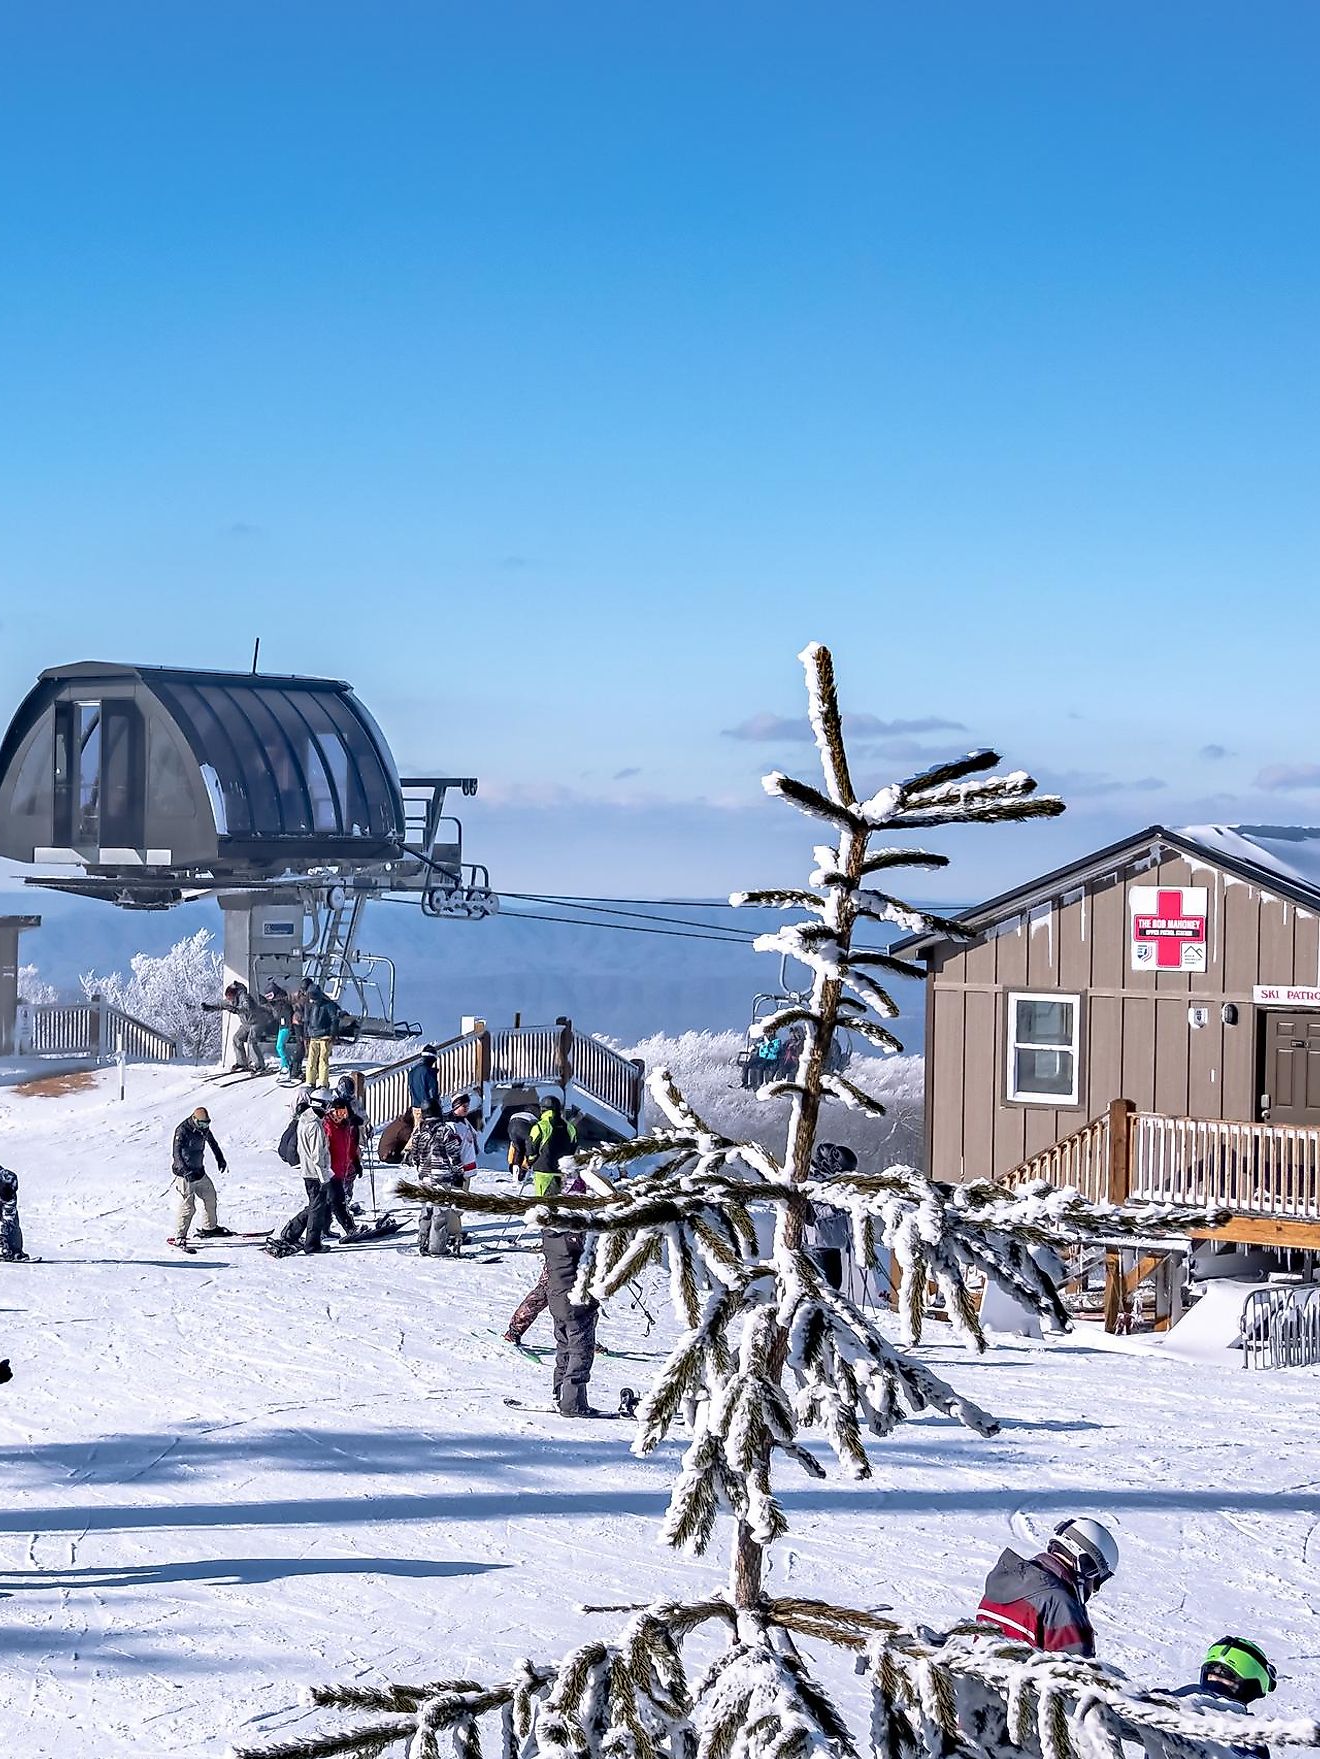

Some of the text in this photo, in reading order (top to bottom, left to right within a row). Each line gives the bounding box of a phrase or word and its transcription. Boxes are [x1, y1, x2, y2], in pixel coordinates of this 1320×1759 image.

[1138, 919, 1201, 930] THE BOB MAHONEY
[1261, 990, 1280, 999] SKI
